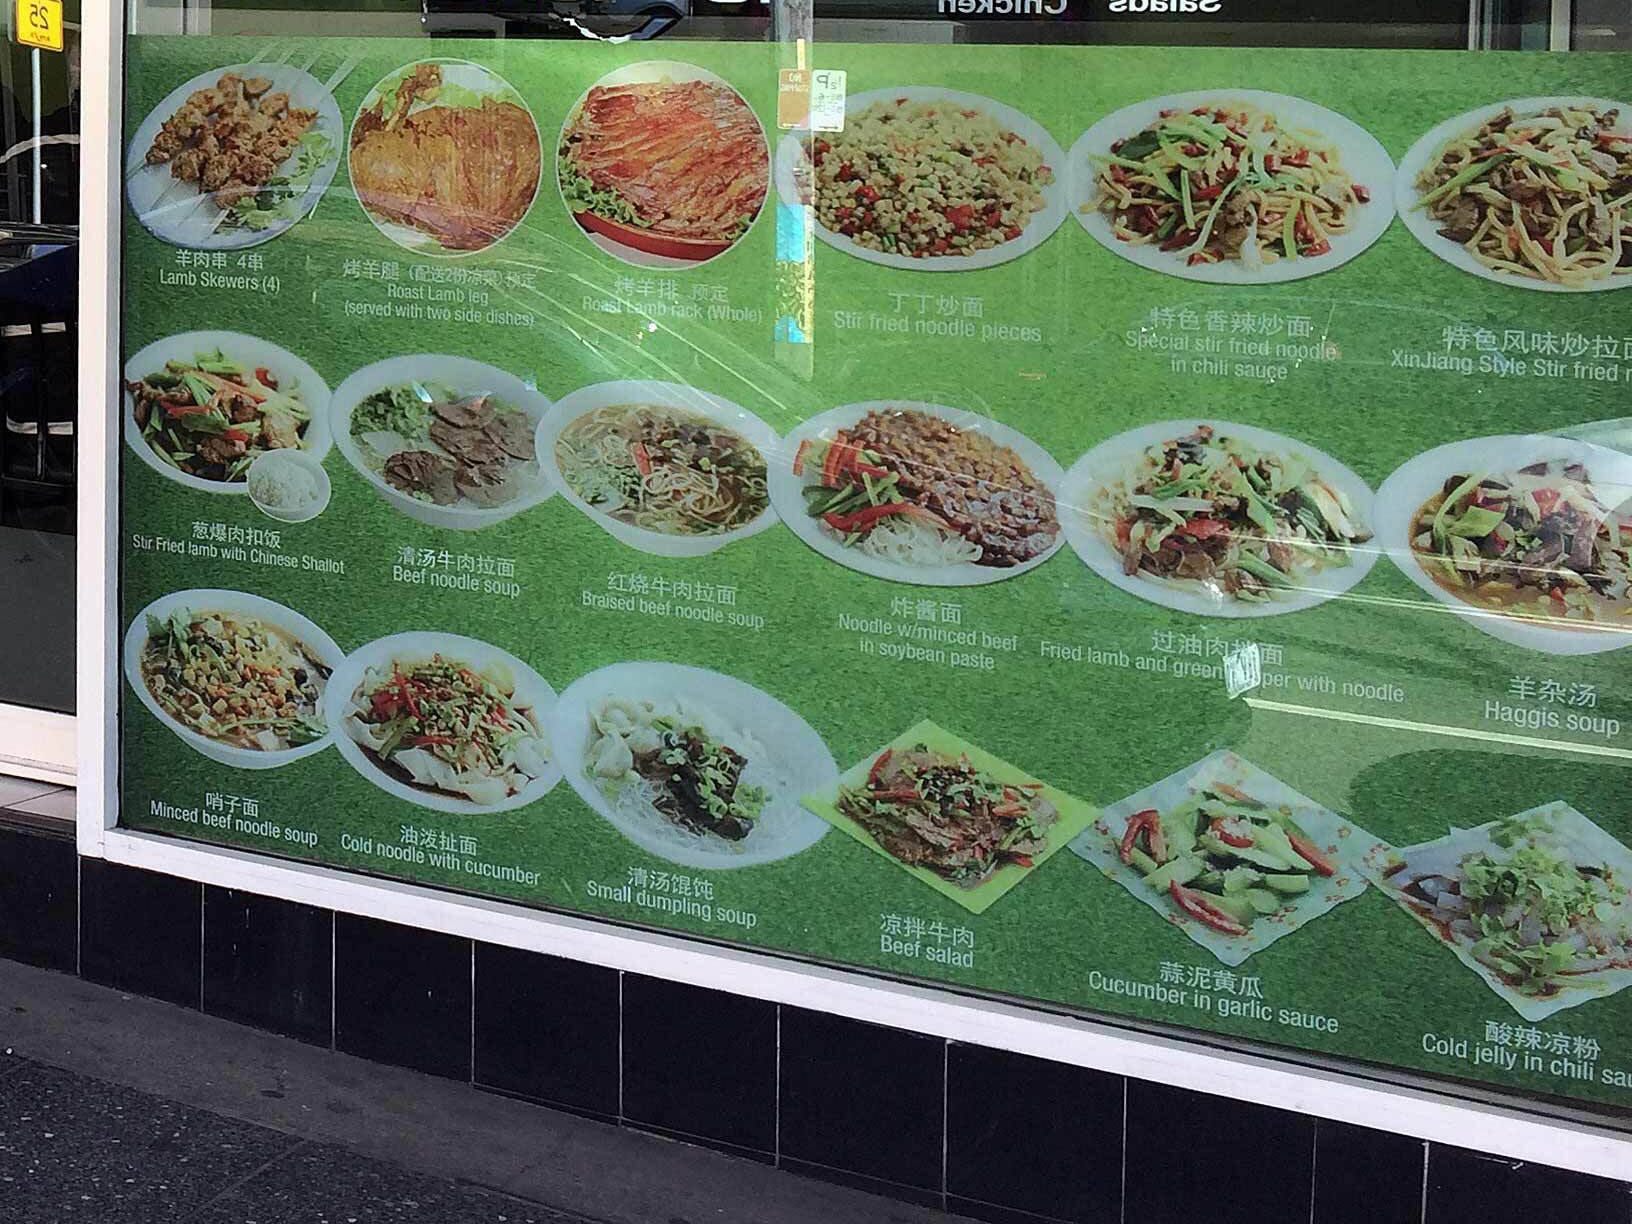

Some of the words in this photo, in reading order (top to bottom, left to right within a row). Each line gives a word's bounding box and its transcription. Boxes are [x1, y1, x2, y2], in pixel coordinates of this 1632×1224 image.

[175, 249, 227, 269] 羊肉串
[160, 269, 198, 288] Lamb
[200, 272, 259, 291] Skewers
[262, 274, 280, 294] (4)
[387, 283, 424, 300] Roast
[428, 285, 465, 303] Lamb
[469, 288, 489, 307] leg
[344, 299, 392, 317] (served
[395, 304, 423, 319] with
[426, 307, 452, 321] two
[454, 308, 482, 323] side
[486, 309, 535, 329] dishes)
[582, 295, 622, 313] Roast
[626, 297, 667, 315] Lamb
[670, 299, 704, 318] rack
[707, 302, 763, 323] (Whole)
[889, 292, 986, 319] 丁丁炒面
[1148, 306, 1312, 339] 特色香辣炒面
[833, 310, 864, 330] Stir
[869, 312, 911, 333] fried
[914, 315, 977, 338] noodle
[981, 321, 1043, 344] pieces
[1125, 329, 1190, 353] Special
[1194, 334, 1224, 354] stir
[1229, 337, 1269, 356] fried
[1275, 338, 1337, 361] noodle
[1171, 357, 1187, 374] in
[1192, 358, 1229, 376] chili
[1234, 363, 1288, 381] sauce
[1391, 348, 1473, 375] XinJiang
[1479, 352, 1526, 377] Style
[1532, 357, 1566, 378] Stir
[1572, 359, 1620, 382] fried
[132, 534, 154, 550] Stir
[156, 537, 185, 555] Fried
[188, 540, 218, 558] lamb
[221, 545, 247, 563] with
[250, 548, 299, 569] Chinese
[302, 554, 345, 575] Shallot
[397, 545, 516, 579] 清汤牛肉拉面
[393, 565, 427, 584] Beef
[430, 569, 480, 591] noodle
[483, 577, 520, 600] soup
[607, 572, 738, 606] 红烧牛肉拉面
[582, 590, 635, 612] Braised
[638, 595, 672, 615] beef
[674, 601, 724, 624] noodle
[727, 611, 764, 631] soup
[890, 595, 963, 625] 炸酱面
[838, 612, 893, 634] Noodle
[896, 618, 978, 646] w/minced
[981, 630, 1017, 651] beef
[859, 637, 874, 654] in
[878, 640, 947, 664] soybean
[950, 650, 995, 671] paste
[1040, 640, 1083, 663] Fried
[1087, 645, 1130, 669] lamb
[1134, 652, 1169, 672] and
[1172, 658, 1224, 681] green
[1298, 672, 1337, 695] with
[1342, 680, 1405, 704] noodle
[1509, 676, 1599, 709] 羊杂汤
[1484, 700, 1560, 731] Haggis
[1567, 710, 1621, 740] soup
[205, 791, 260, 819] 哨子面
[150, 799, 199, 824] Minced
[201, 808, 233, 832] beef
[235, 814, 281, 841] noodle
[284, 827, 318, 849] soup
[341, 833, 373, 855] Cold
[376, 841, 426, 865] noodle
[429, 850, 461, 872] with
[464, 858, 541, 887] cucumber
[627, 866, 715, 902] 清汤馄饨
[586, 878, 632, 904] Small
[636, 885, 712, 922] dumpling
[715, 906, 757, 930] soup
[879, 912, 975, 949] 凉拌牛肉
[879, 933, 922, 957] Beef
[926, 945, 974, 969] salad
[1158, 960, 1264, 1000] 蒜泥黄瓜
[1087, 969, 1189, 1007] Cucumber
[1193, 989, 1212, 1011] in
[1217, 995, 1273, 1024] garlic
[1277, 1008, 1340, 1034] sauce
[1421, 1032, 1468, 1060] Cold
[1472, 1041, 1518, 1072] jelly
[1523, 1050, 1543, 1071] in
[1549, 1055, 1596, 1082] chili
[1484, 1019, 1602, 1062] 酸辣凉粉
